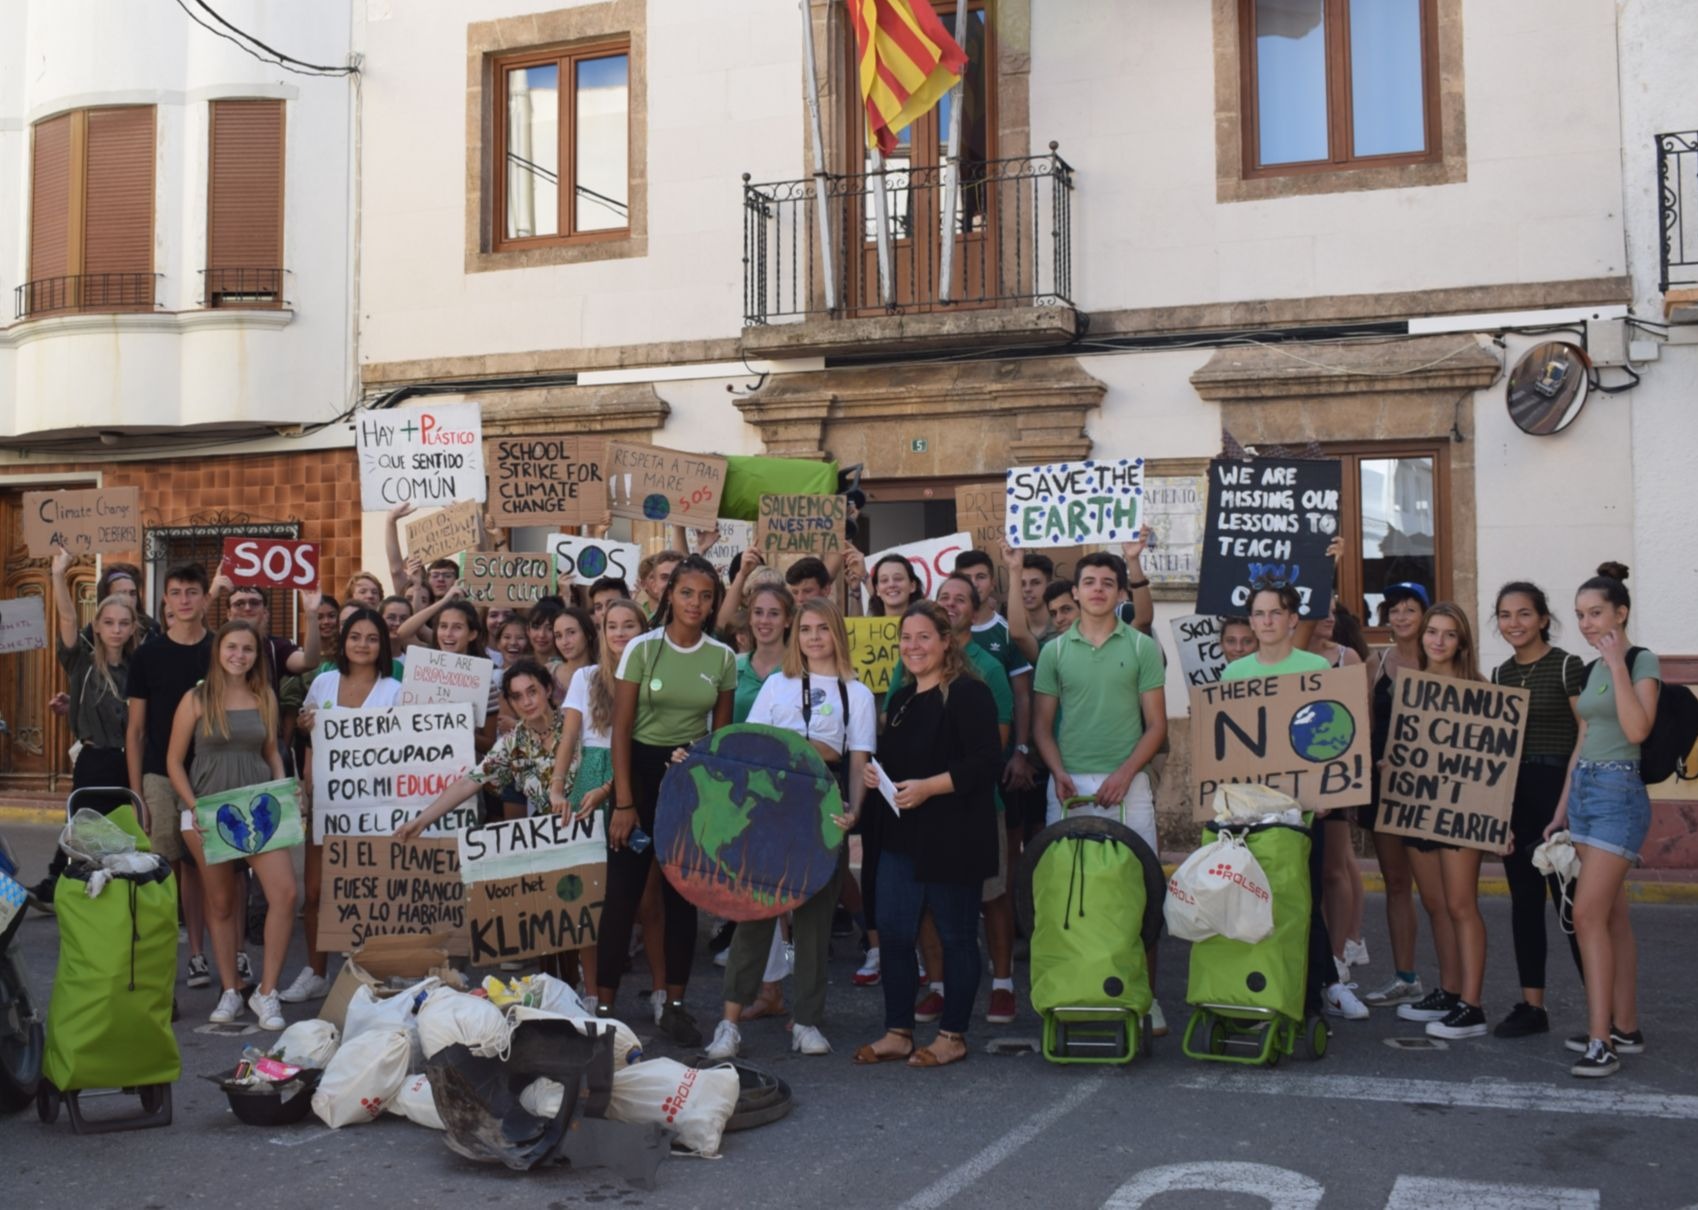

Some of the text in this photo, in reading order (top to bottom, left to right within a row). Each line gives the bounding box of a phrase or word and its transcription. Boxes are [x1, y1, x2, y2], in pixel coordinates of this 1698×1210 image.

[498, 441, 570, 461] SCHOOL
[916, 440, 923, 451] 5
[378, 454, 405, 470] QUE
[499, 462, 603, 483] STRIKE FOR
[381, 470, 456, 504] COMÚN
[1014, 464, 1141, 501] SAVE THE
[1218, 465, 1298, 487] WE ARE
[499, 481, 579, 499] CLIMATE
[679, 485, 713, 512] SOS
[1220, 489, 1339, 511] MISSING OUR
[40, 496, 130, 523] Climate Change
[502, 498, 566, 513] CHANGE
[761, 495, 844, 521] SALVEMOS
[1023, 496, 1137, 541] EARTH
[768, 517, 834, 533] NUESTRO
[1217, 512, 1337, 535] LESSONS TO
[765, 532, 839, 553] PLANETA
[1218, 537, 1292, 560] TEACH
[234, 542, 315, 585] SOS
[1202, 674, 1323, 705] THERE IS
[1402, 677, 1523, 726] URANUS
[324, 707, 469, 741] DEBERÍA ESTAR
[1394, 713, 1519, 758] IS CLEAN
[329, 744, 454, 772] PREOCUPADA
[1388, 743, 1508, 787] SO WHY
[1320, 754, 1363, 795] B!
[327, 778, 371, 801] POR
[373, 776, 392, 797] MI
[324, 813, 351, 834] NO
[358, 812, 387, 833] EL
[1381, 798, 1509, 845] THE EARTH
[465, 810, 596, 861] STAKEN
[329, 840, 347, 868] SI
[357, 842, 377, 866] EL
[334, 877, 464, 903] FUESE UN BANCO
[1222, 869, 1269, 903] ROLSER
[337, 901, 464, 928] YA LO HABRÍAIS
